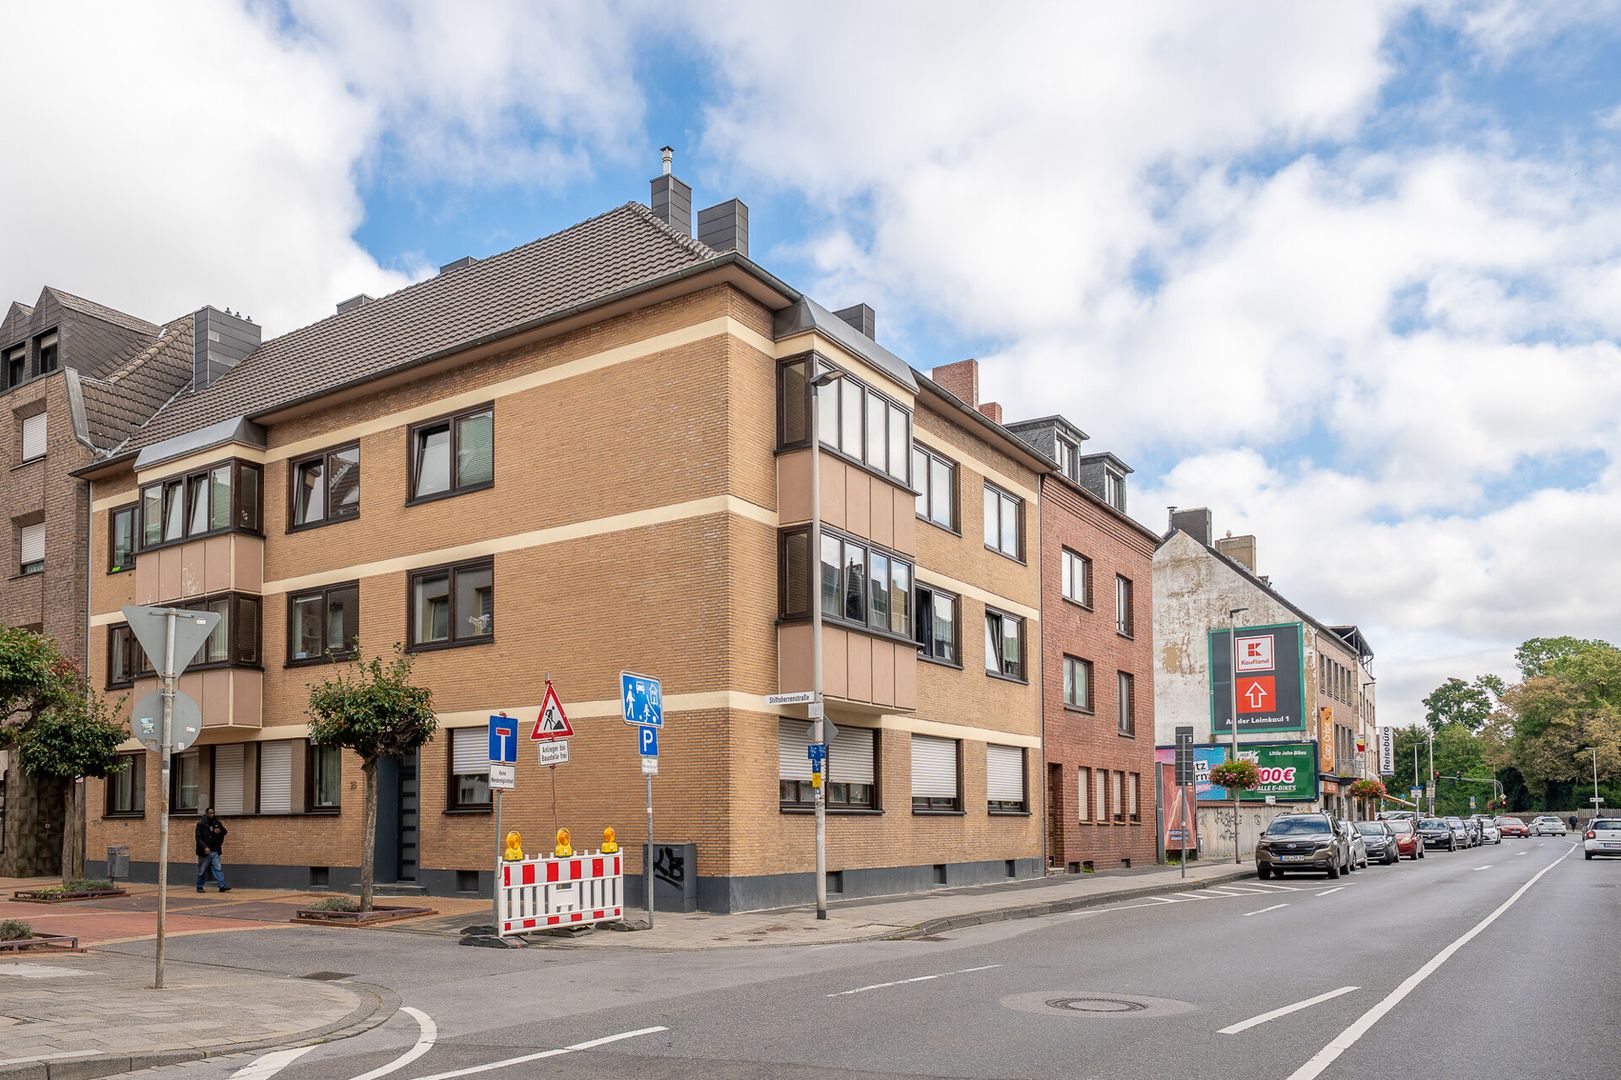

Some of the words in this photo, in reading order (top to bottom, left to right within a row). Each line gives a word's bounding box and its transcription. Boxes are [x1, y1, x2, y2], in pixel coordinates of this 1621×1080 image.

[1241, 658, 1269, 666] Kaufland
[769, 693, 810, 704] Stiftsherrenstraße
[1251, 716, 1284, 724] Leimkaul
[643, 729, 654, 752] P
[542, 745, 558, 754] Anlieger
[1383, 726, 1391, 771] Reisebüro
[541, 753, 559, 762] Baustelle
[1195, 762, 1206, 771] tz
[1260, 768, 1295, 783] 00€
